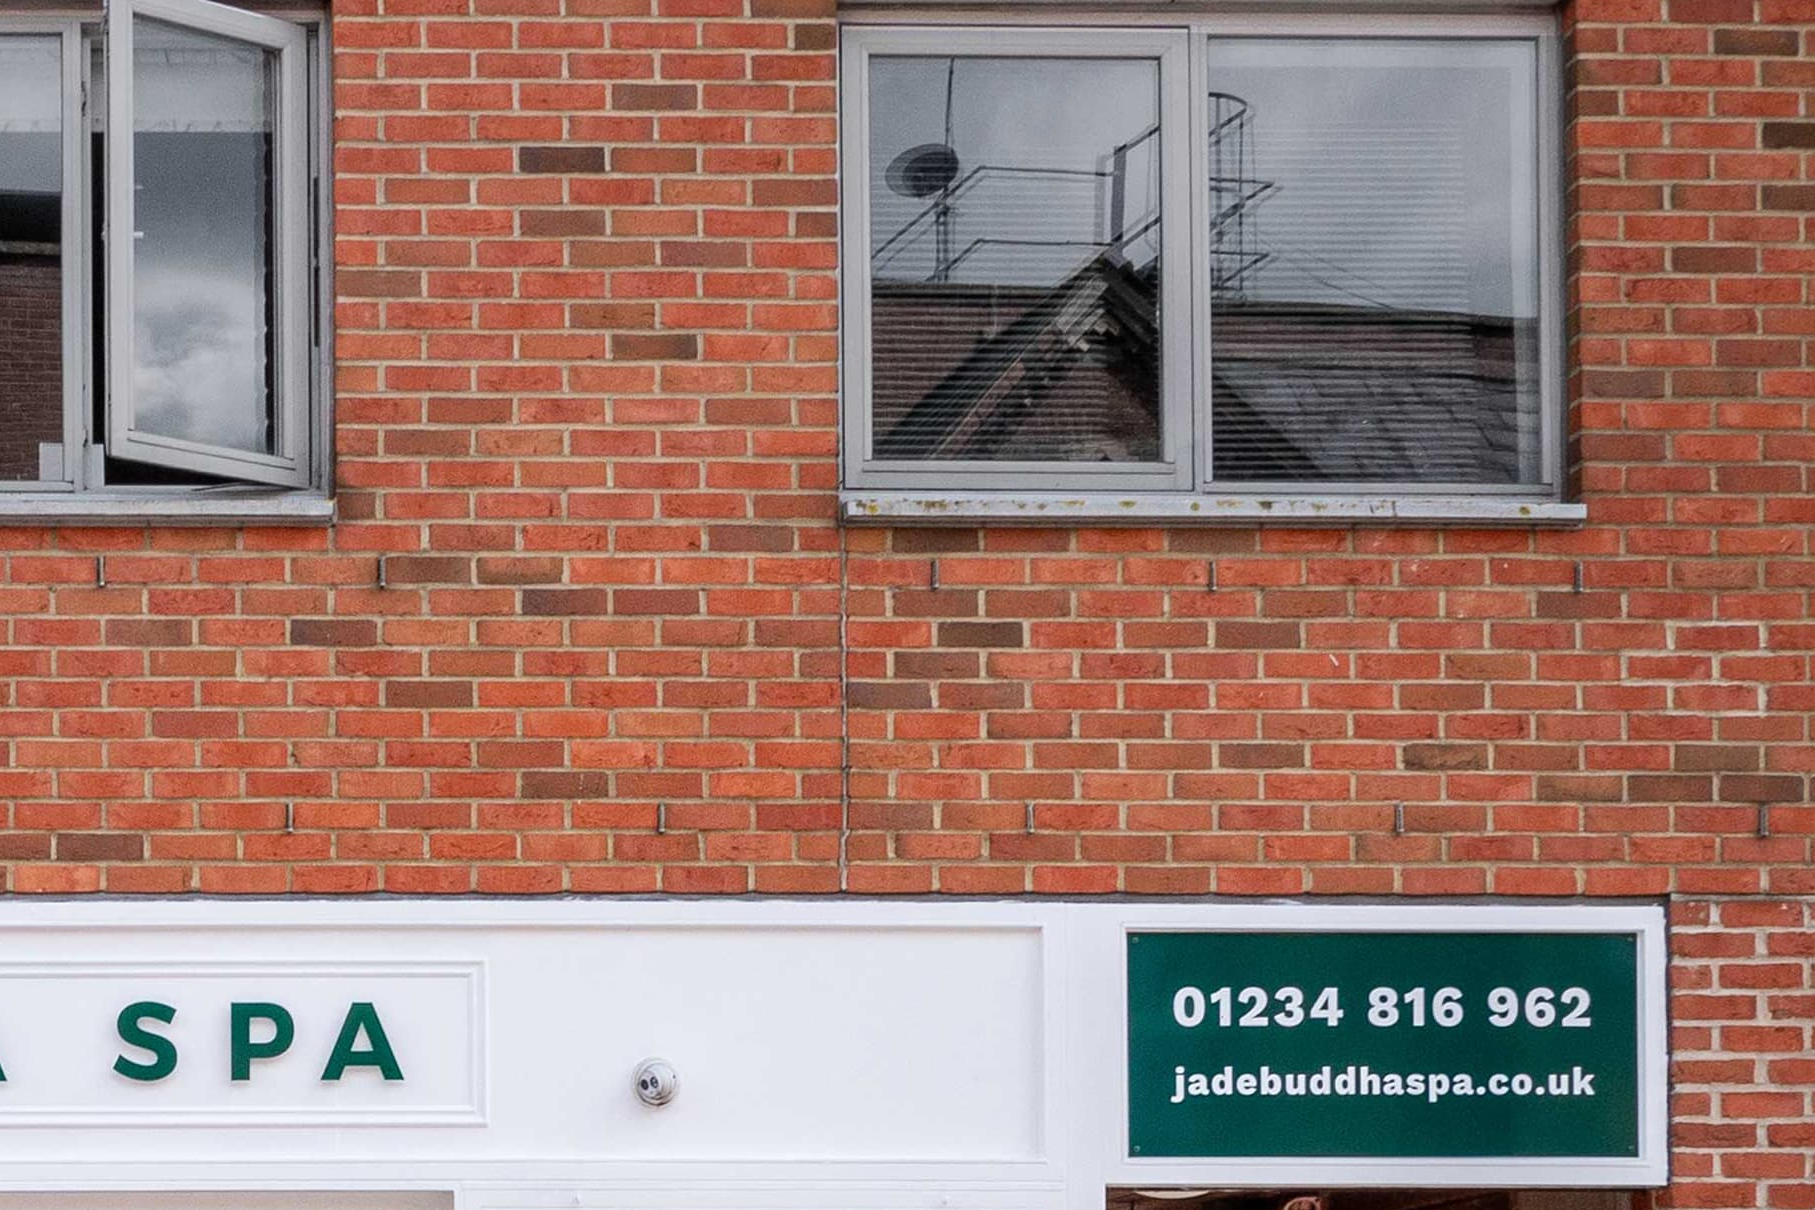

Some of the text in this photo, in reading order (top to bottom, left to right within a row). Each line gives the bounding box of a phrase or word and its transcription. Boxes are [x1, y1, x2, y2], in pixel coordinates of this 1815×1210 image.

[1172, 986, 1592, 1028] 01234 816 962
[112, 1001, 405, 1082] SPA
[1170, 1065, 1595, 1104] jadebuddhaspa.co.uk
